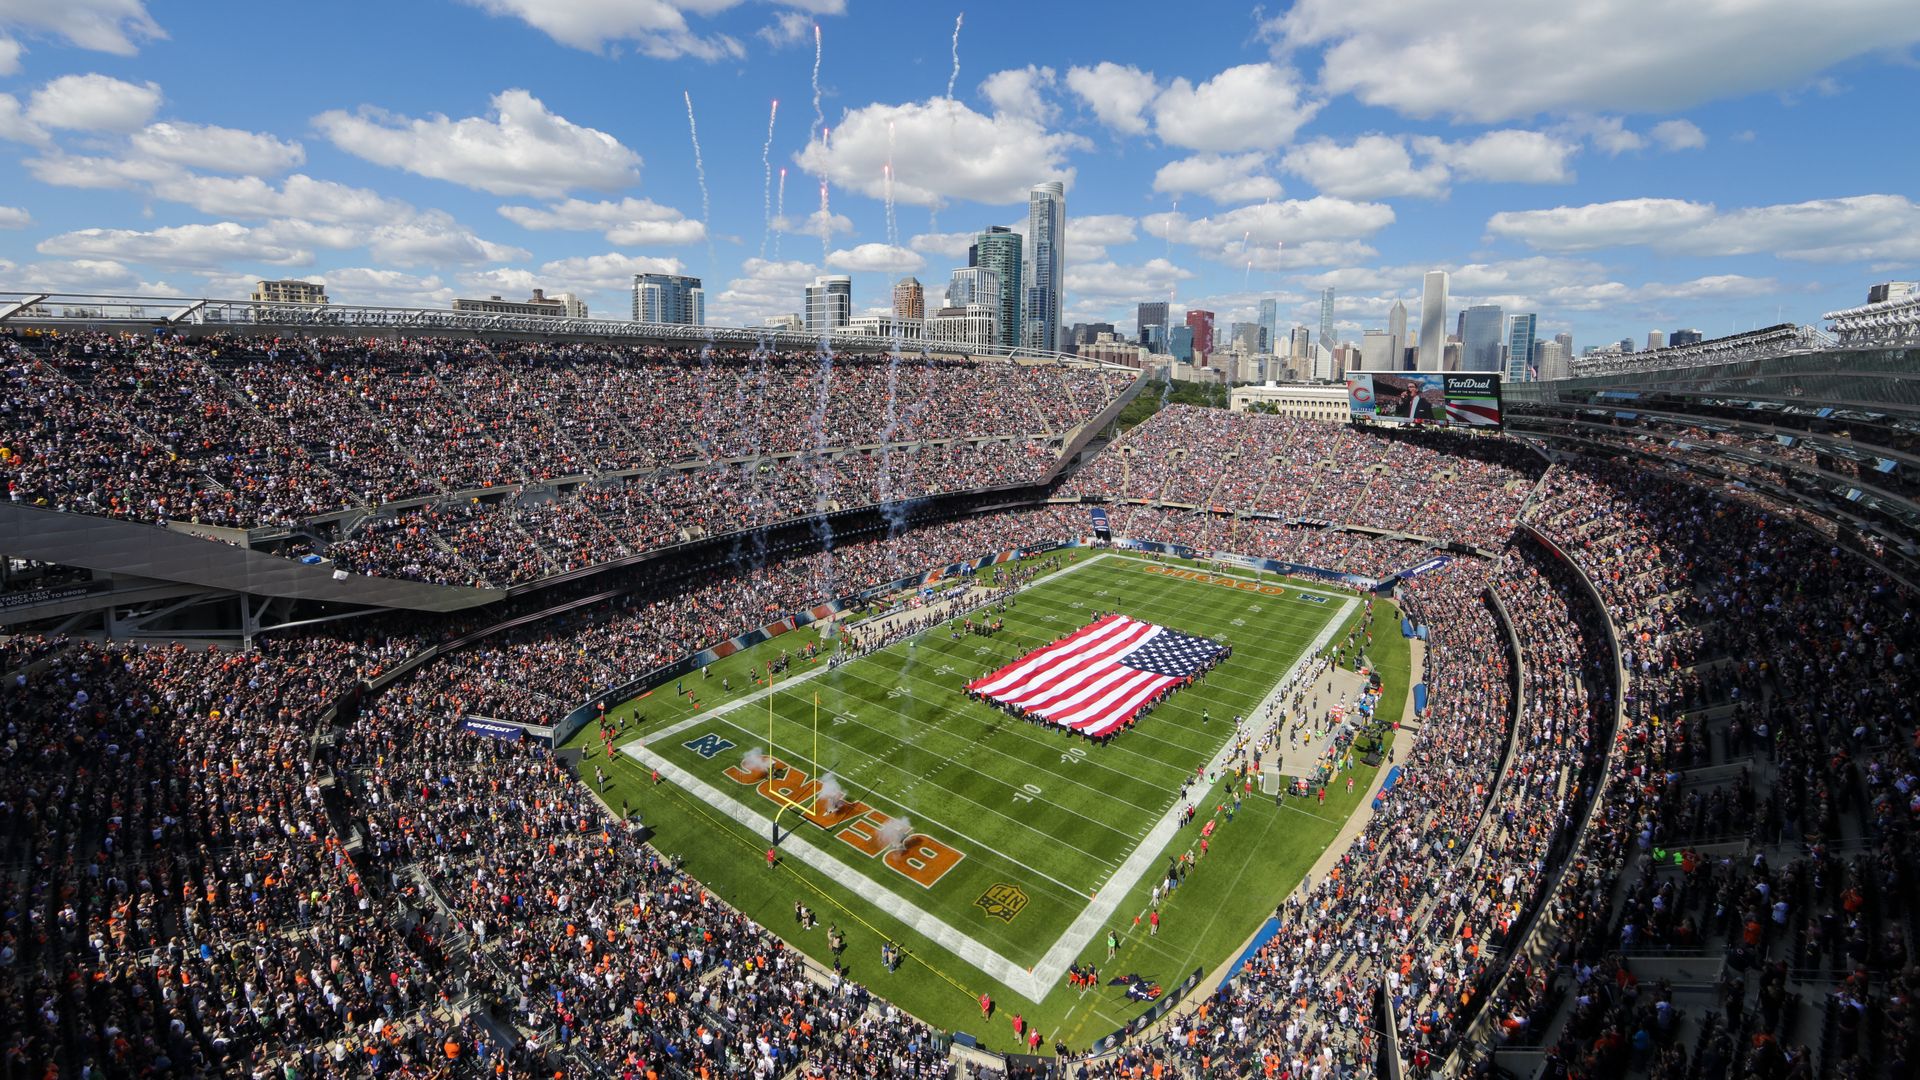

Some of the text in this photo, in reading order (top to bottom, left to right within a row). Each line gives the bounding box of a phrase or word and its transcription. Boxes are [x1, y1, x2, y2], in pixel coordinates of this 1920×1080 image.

[1448, 378, 1490, 389] FanDuel
[1143, 565, 1285, 595] CHICAGO
[7, 595, 48, 606] LOCATION
[833, 710, 858, 724] 10
[467, 721, 510, 733] verizon
[1061, 748, 1087, 764] 20
[1013, 784, 1042, 803] 10
[722, 755, 967, 890] BEARS
[992, 886, 1025, 910] NFL
